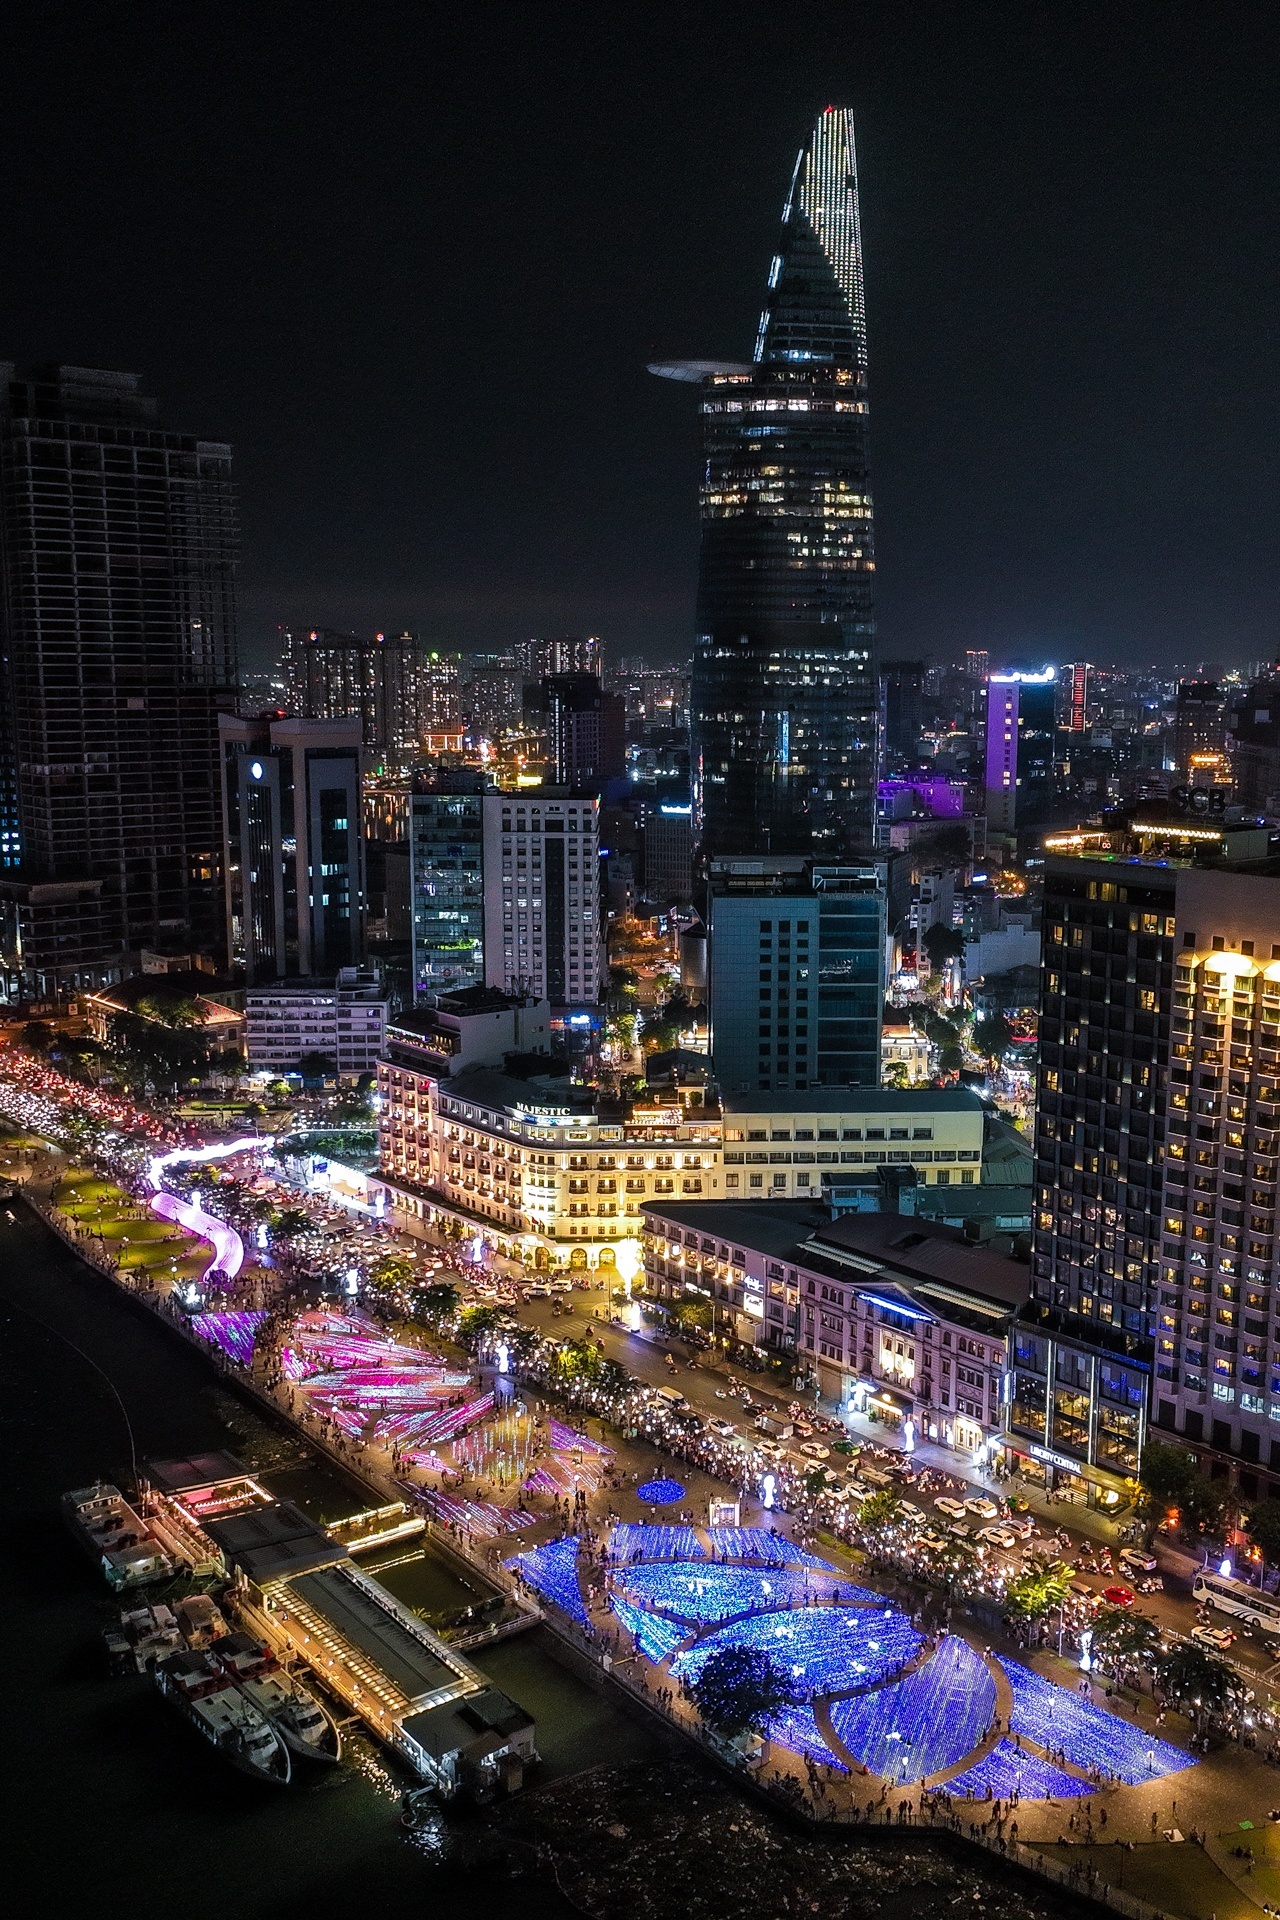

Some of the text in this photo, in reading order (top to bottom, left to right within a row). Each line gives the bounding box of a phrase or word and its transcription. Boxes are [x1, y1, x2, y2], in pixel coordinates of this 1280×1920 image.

[1171, 785, 1226, 814] SCB
[516, 1101, 571, 1116] MAJESTIC
[1030, 1444, 1082, 1475] LIBERTY CENTRAL
